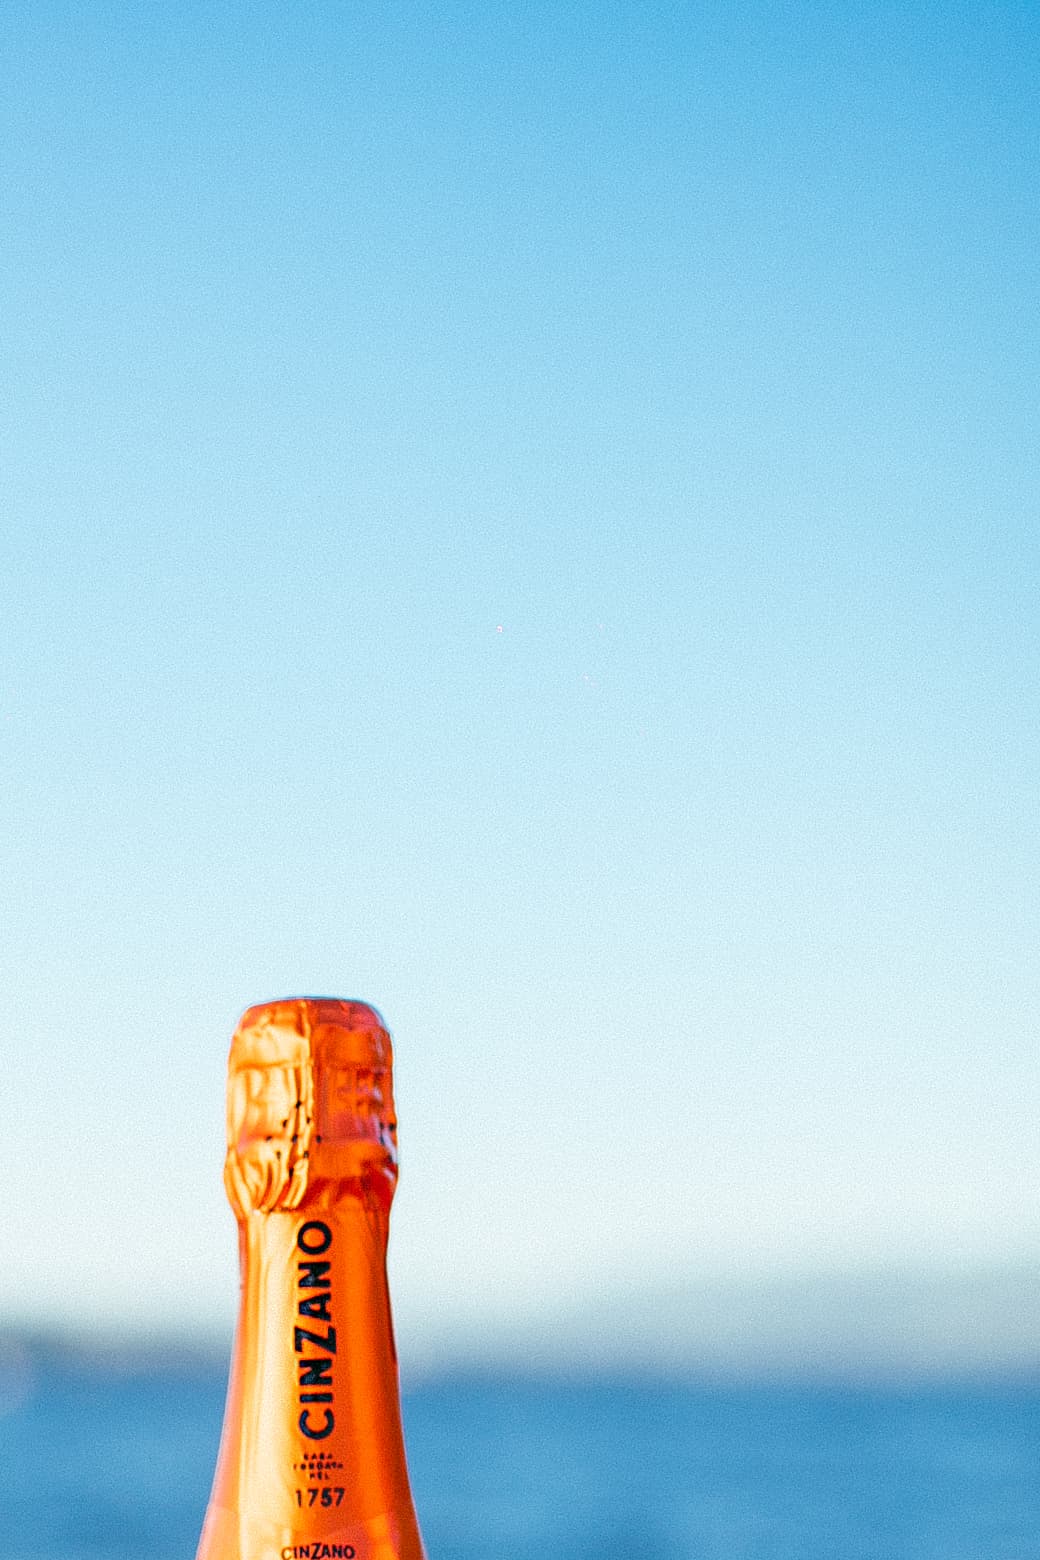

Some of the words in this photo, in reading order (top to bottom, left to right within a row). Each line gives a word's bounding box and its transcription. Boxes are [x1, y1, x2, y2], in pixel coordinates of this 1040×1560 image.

[294, 1220, 337, 1440] CINZANO
[296, 1487, 346, 1508] 1757
[281, 1542, 356, 1560] CINZANO
